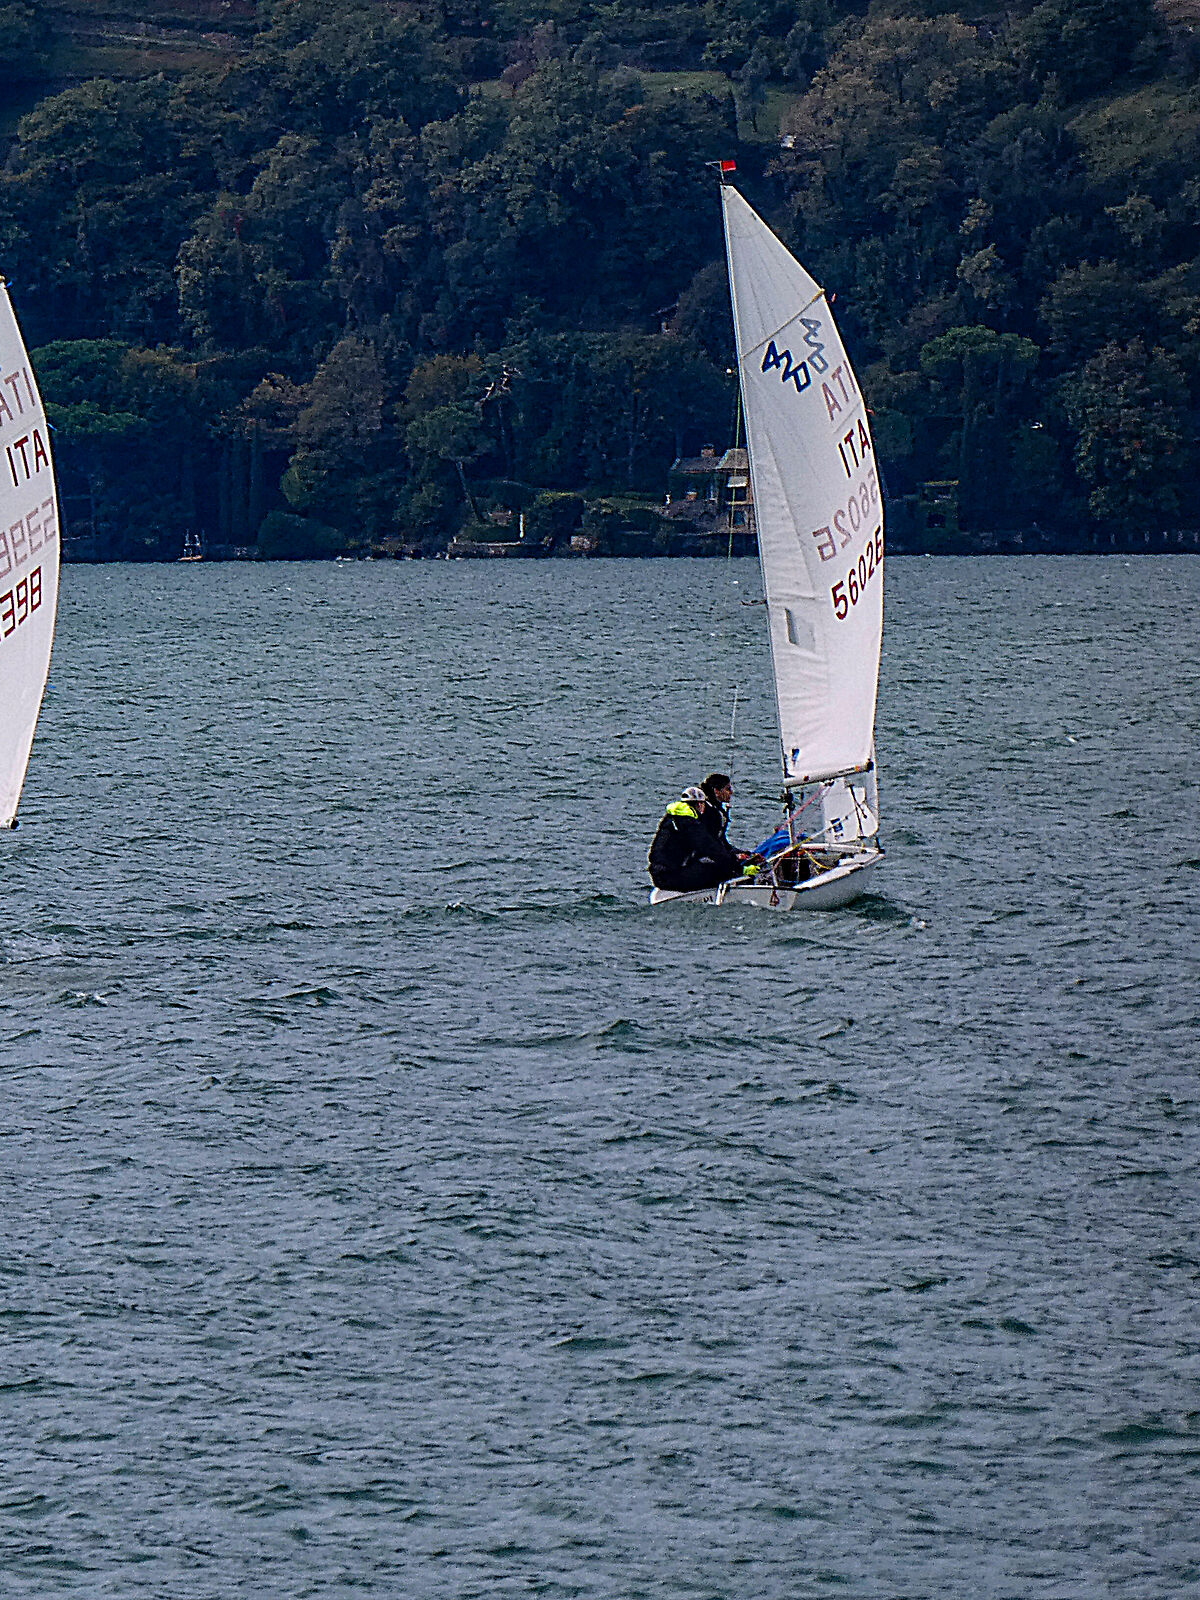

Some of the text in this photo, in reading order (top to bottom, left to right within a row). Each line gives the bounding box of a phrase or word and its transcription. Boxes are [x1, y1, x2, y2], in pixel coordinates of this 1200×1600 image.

[761, 340, 812, 393] 420
[6, 428, 50, 487] ITA
[837, 418, 872, 478] ITA
